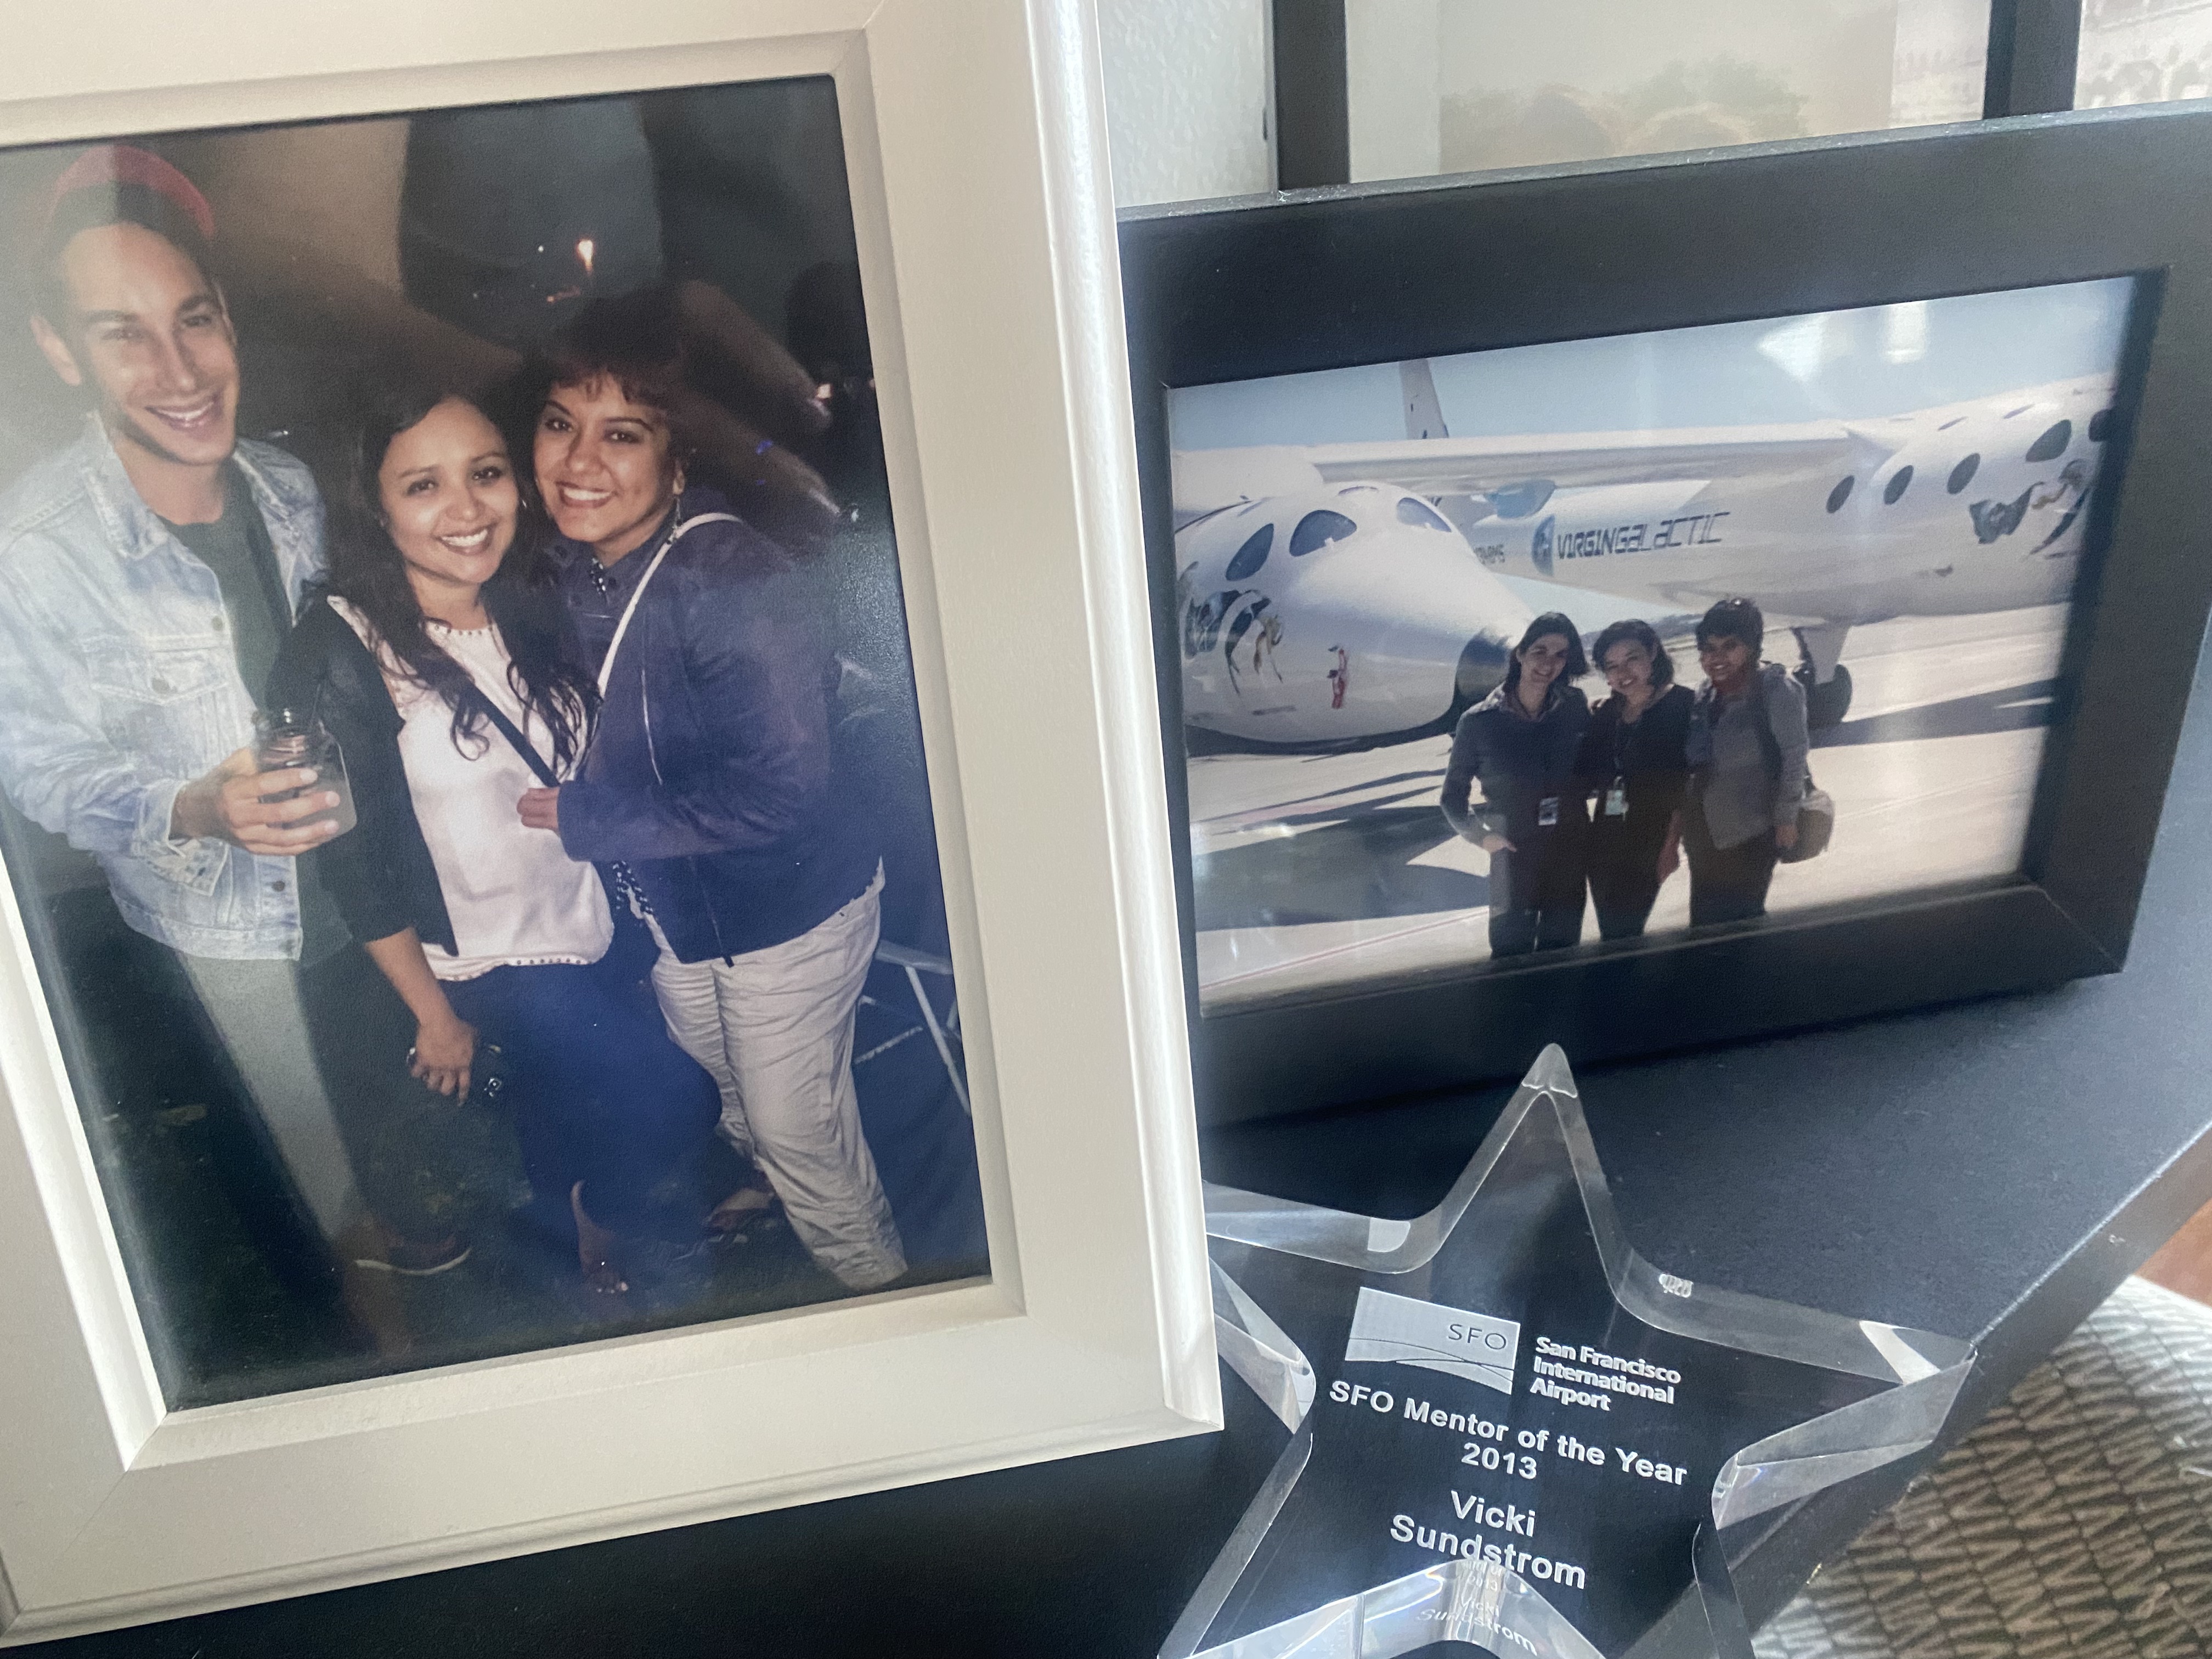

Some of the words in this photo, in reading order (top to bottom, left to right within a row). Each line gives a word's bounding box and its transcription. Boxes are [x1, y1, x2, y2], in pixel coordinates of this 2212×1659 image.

[1447, 1323, 1508, 1351] SFO
[1535, 1336, 1577, 1361] San
[1579, 1346, 1681, 1385] Francisco
[1530, 1377, 1612, 1412] Airport
[1533, 1357, 1674, 1404] International
[1329, 1380, 1394, 1413] SFO
[1403, 1397, 1509, 1441] Mentor
[1517, 1430, 1549, 1450] of
[1557, 1435, 1605, 1466] the
[1615, 1447, 1688, 1486] Year
[1461, 1442, 1537, 1480] 2013
[1451, 1489, 1536, 1537] Vicki
[1390, 1514, 1586, 1590] Sundstrom
